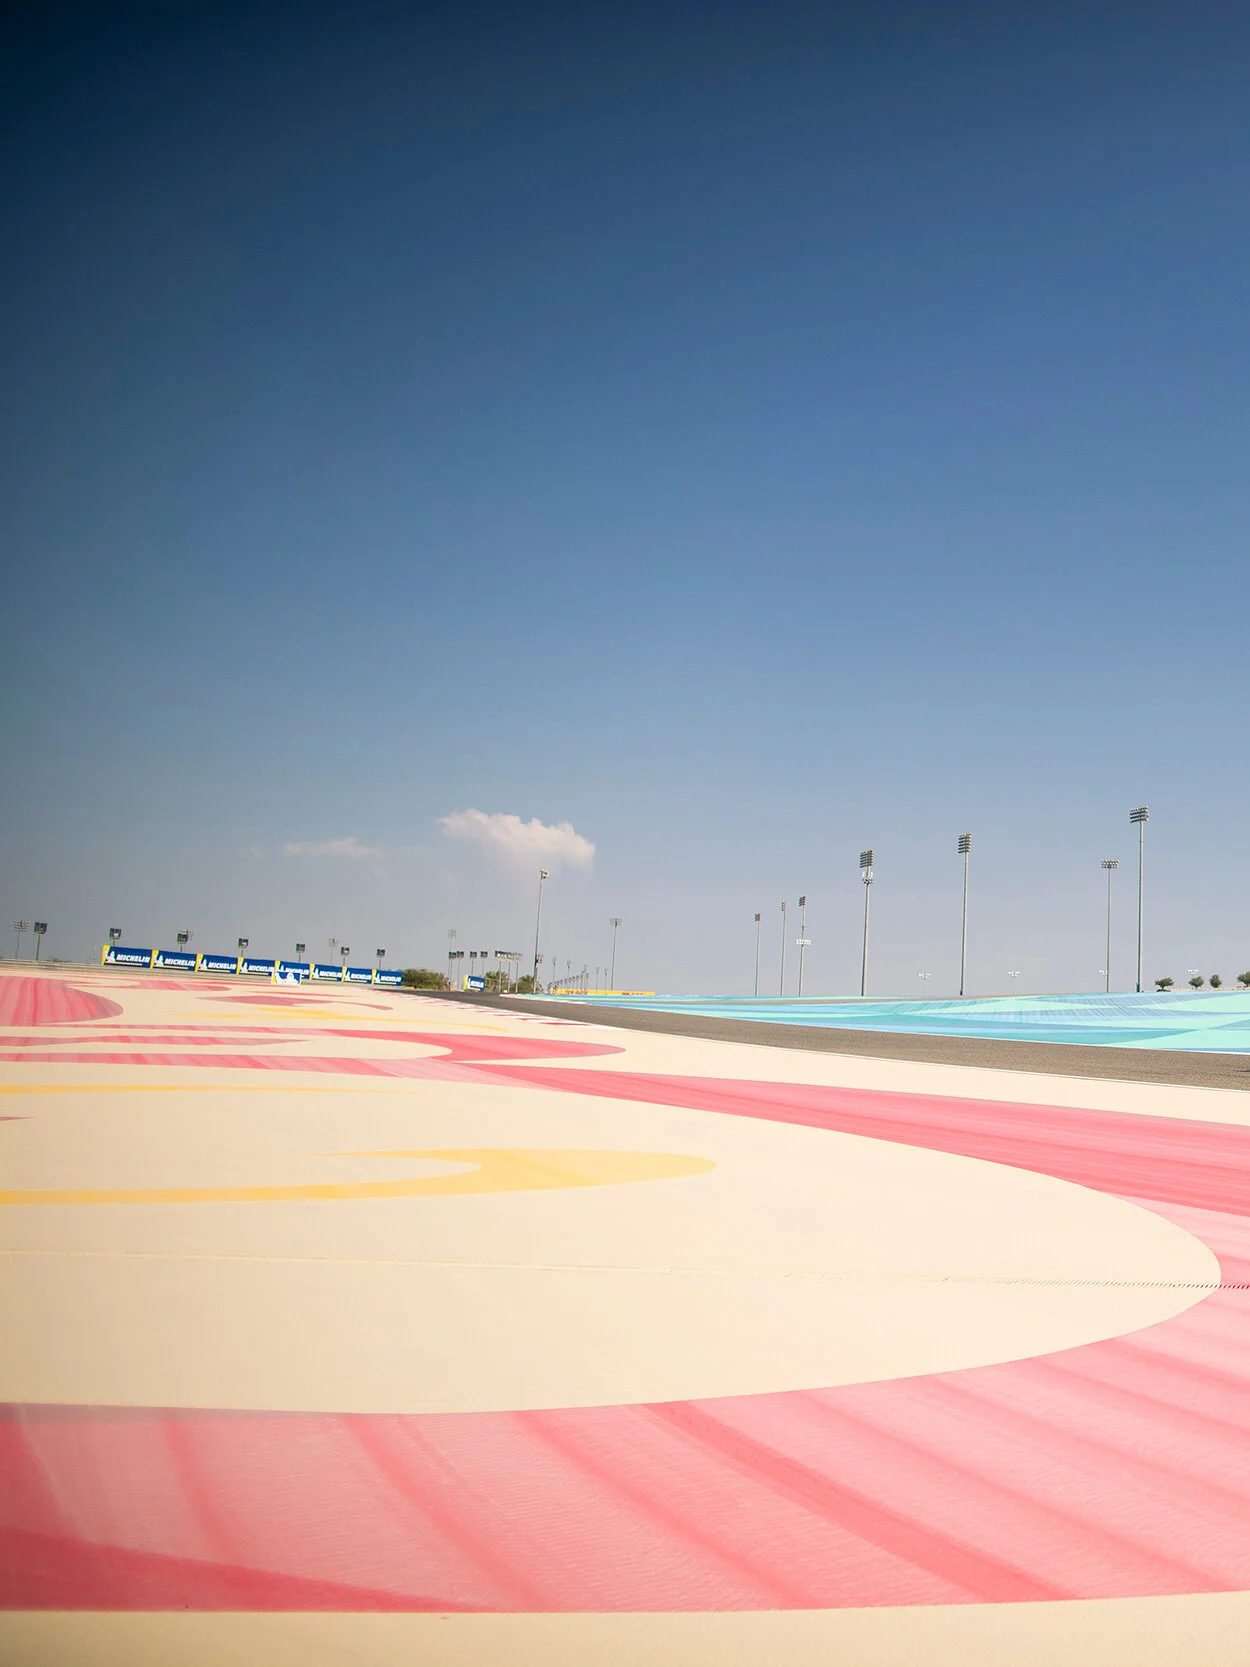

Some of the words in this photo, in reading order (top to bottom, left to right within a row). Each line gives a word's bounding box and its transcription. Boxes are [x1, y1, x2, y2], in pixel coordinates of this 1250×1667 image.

[116, 954, 150, 963] MICHELIN
[164, 957, 196, 967] MICHELIN
[208, 961, 237, 970] MICHELIN
